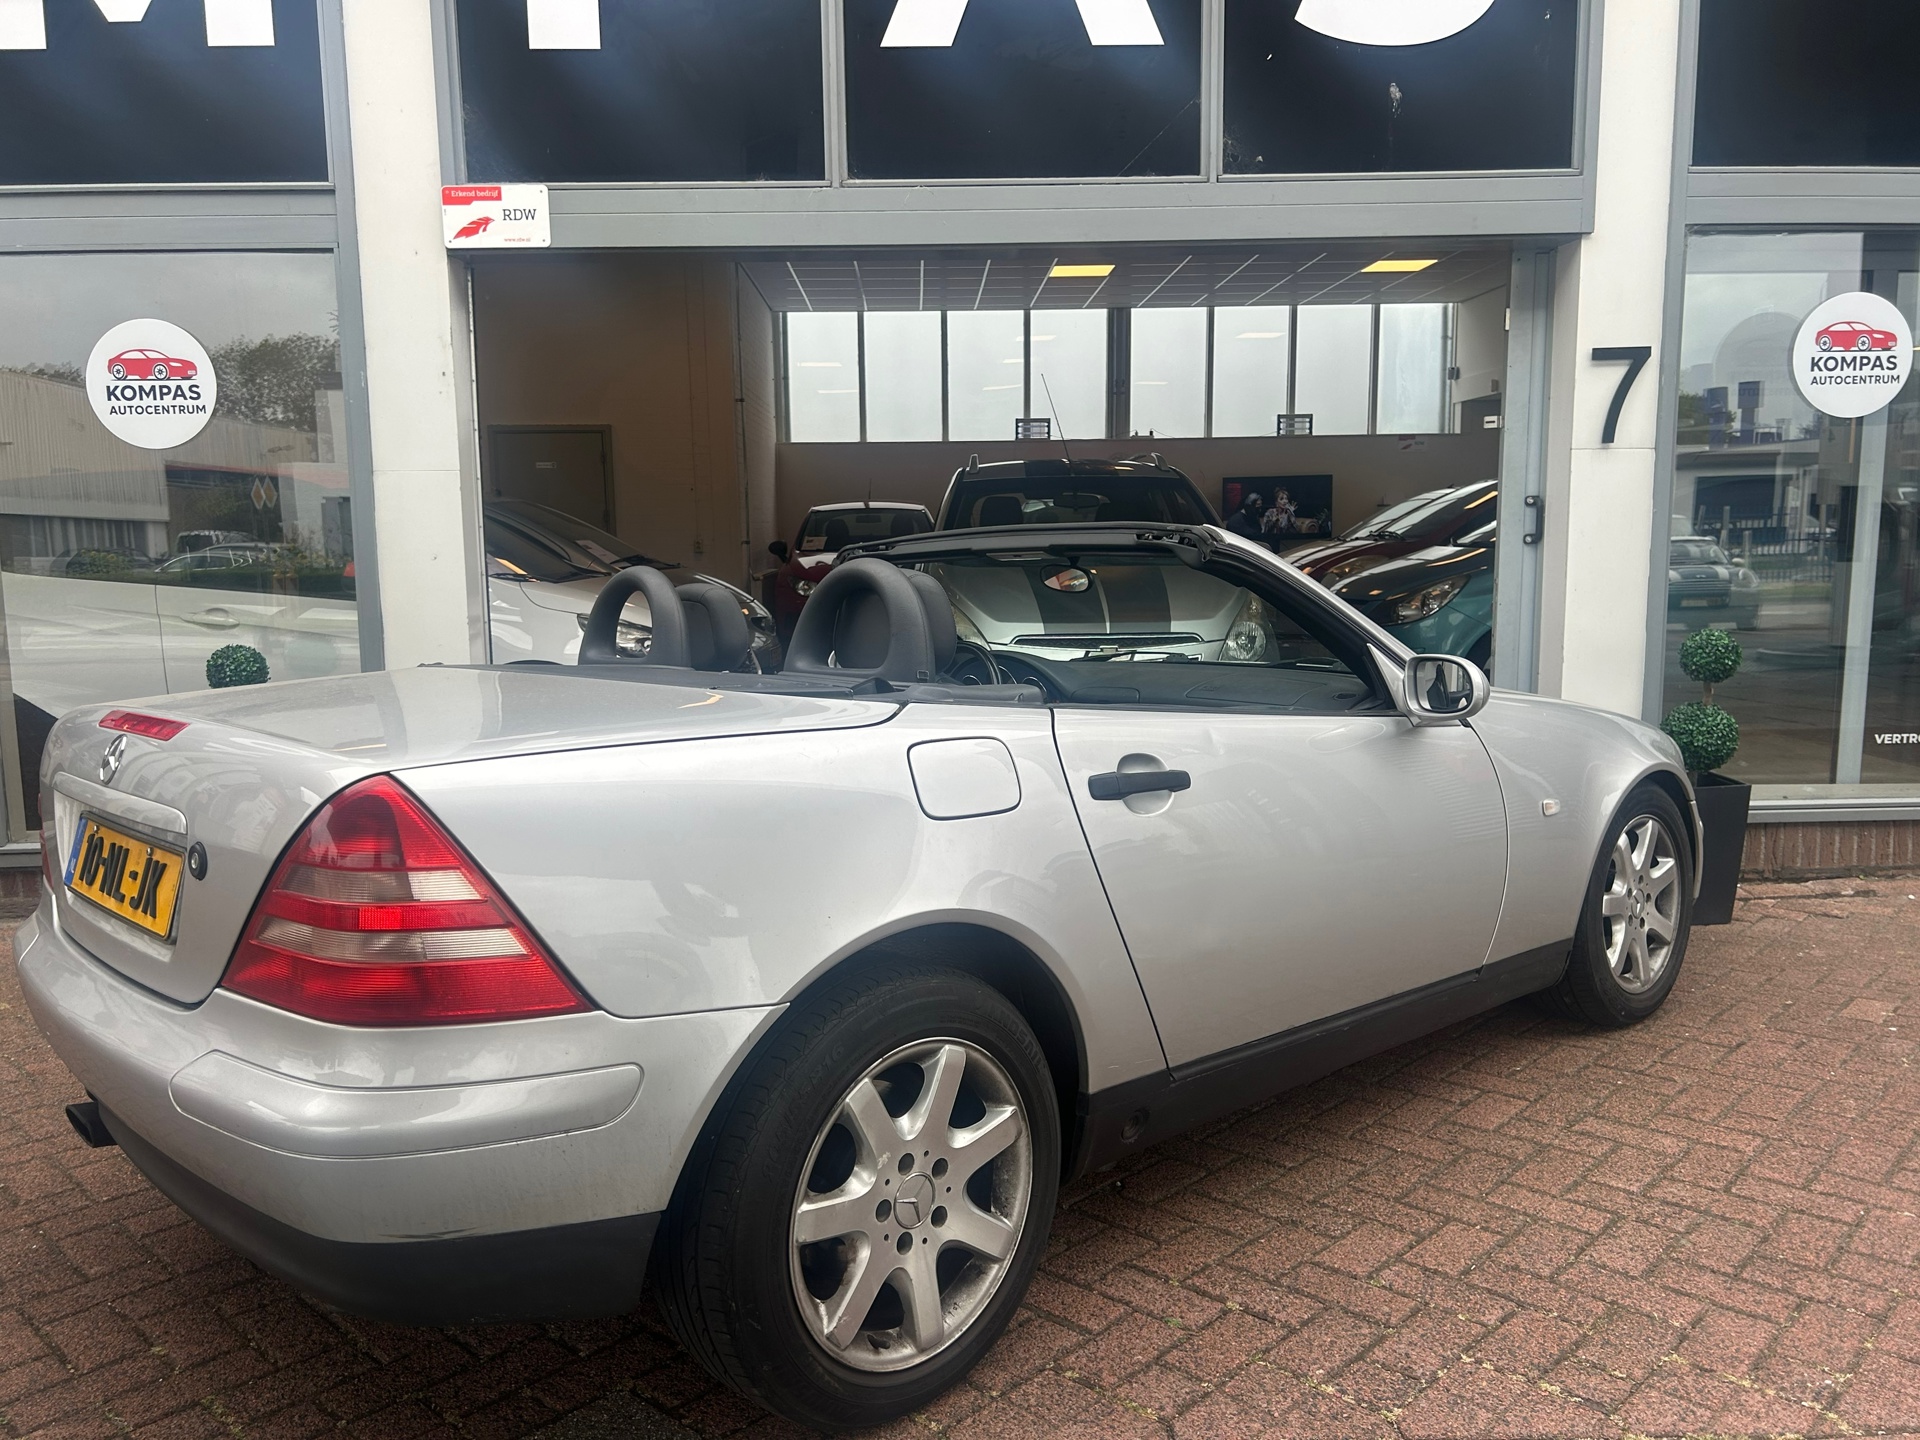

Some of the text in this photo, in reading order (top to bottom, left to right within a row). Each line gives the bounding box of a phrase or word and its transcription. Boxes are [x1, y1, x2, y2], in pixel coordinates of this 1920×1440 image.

[451, 189, 499, 199] Erkend bedrijf
[502, 208, 537, 221] RDW
[1810, 355, 1898, 372] KOMPAS
[1810, 374, 1900, 386] AUTOCENTRUM
[106, 384, 202, 402] KOMPAS
[1591, 346, 1652, 443] 7
[109, 404, 207, 416] AUTOCENTRUM
[1874, 733, 1920, 745] VERTR
[78, 833, 168, 919] 10-NL-JK
